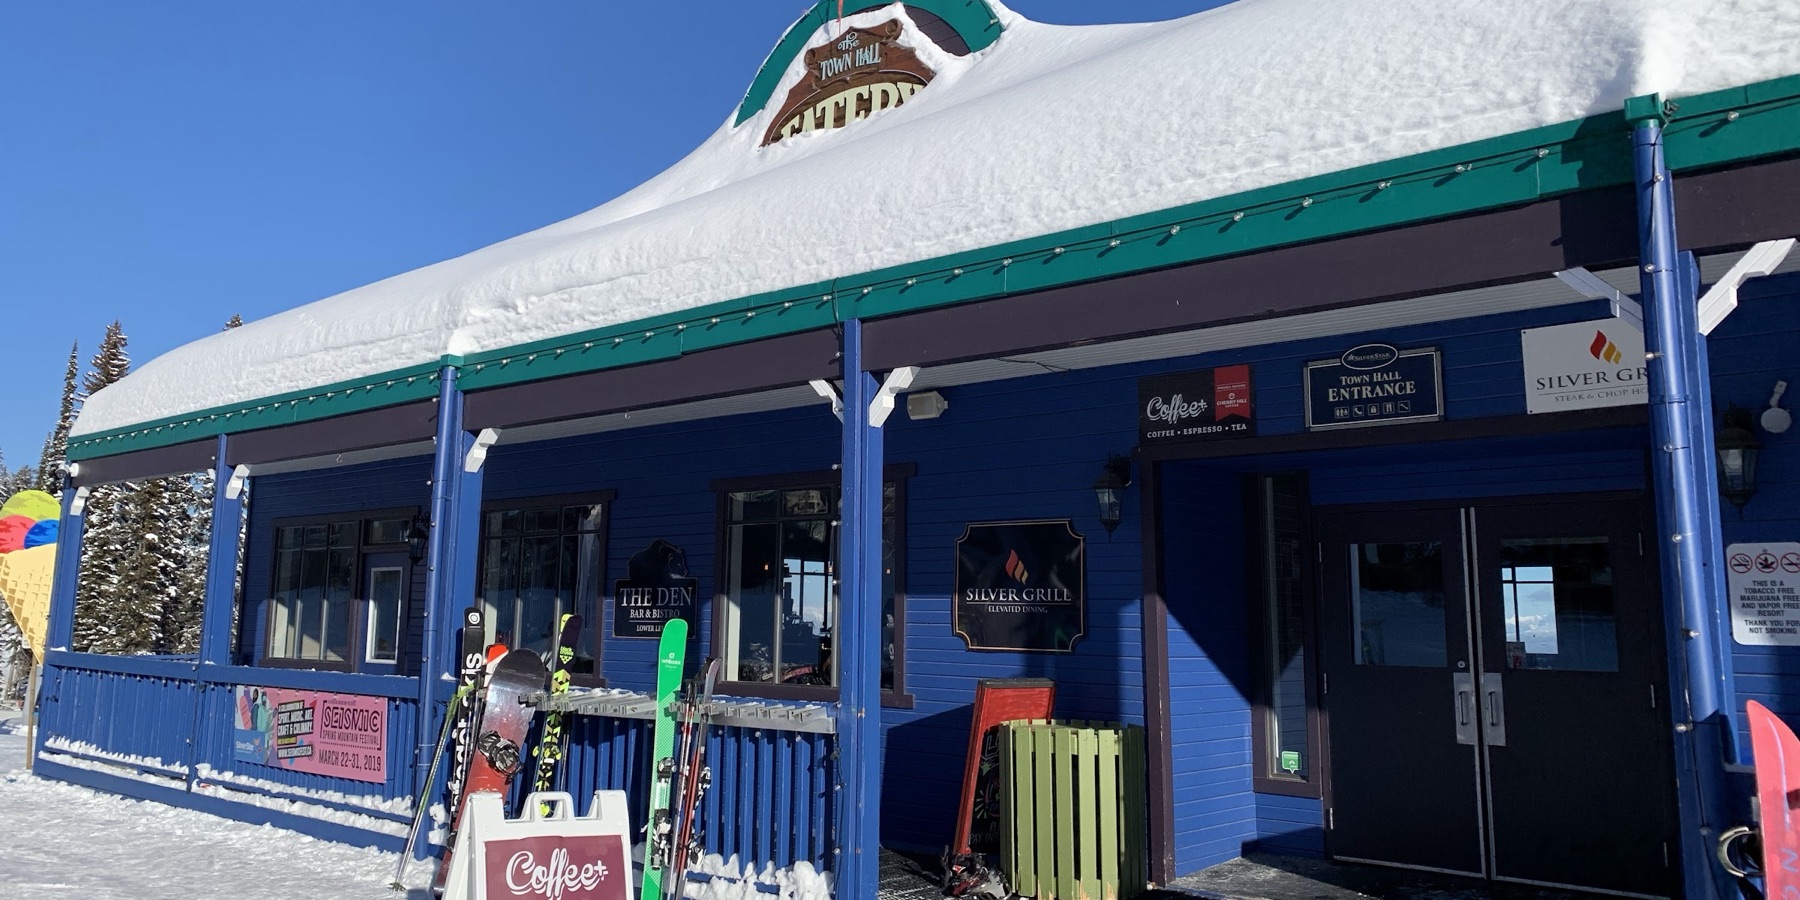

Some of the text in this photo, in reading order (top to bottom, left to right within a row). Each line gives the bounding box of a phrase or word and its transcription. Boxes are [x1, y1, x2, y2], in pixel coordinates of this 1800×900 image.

[837, 31, 860, 51] The
[820, 43, 882, 81] TOWN HALL
[1340, 372, 1402, 386] TOWN HALL
[1536, 371, 1609, 390] SILVER
[1328, 381, 1416, 402] ENTRANCE
[1554, 394, 1584, 402] STEAK
[1598, 390, 1628, 398] CHOP
[1147, 430, 1175, 438] COFFEE
[1184, 426, 1222, 435] ESPRESSO
[620, 586, 692, 606] THE DEN
[966, 588, 1072, 602] SILVER GRILL
[630, 609, 680, 618] BAR & BISTRO
[324, 706, 380, 733] SEISMIC
[322, 730, 379, 746] SPRING MOUNTAIN FESTIVAL
[319, 749, 339, 766] MARCH
[340, 752, 362, 772] 22-31,
[364, 754, 381, 772] 2019
